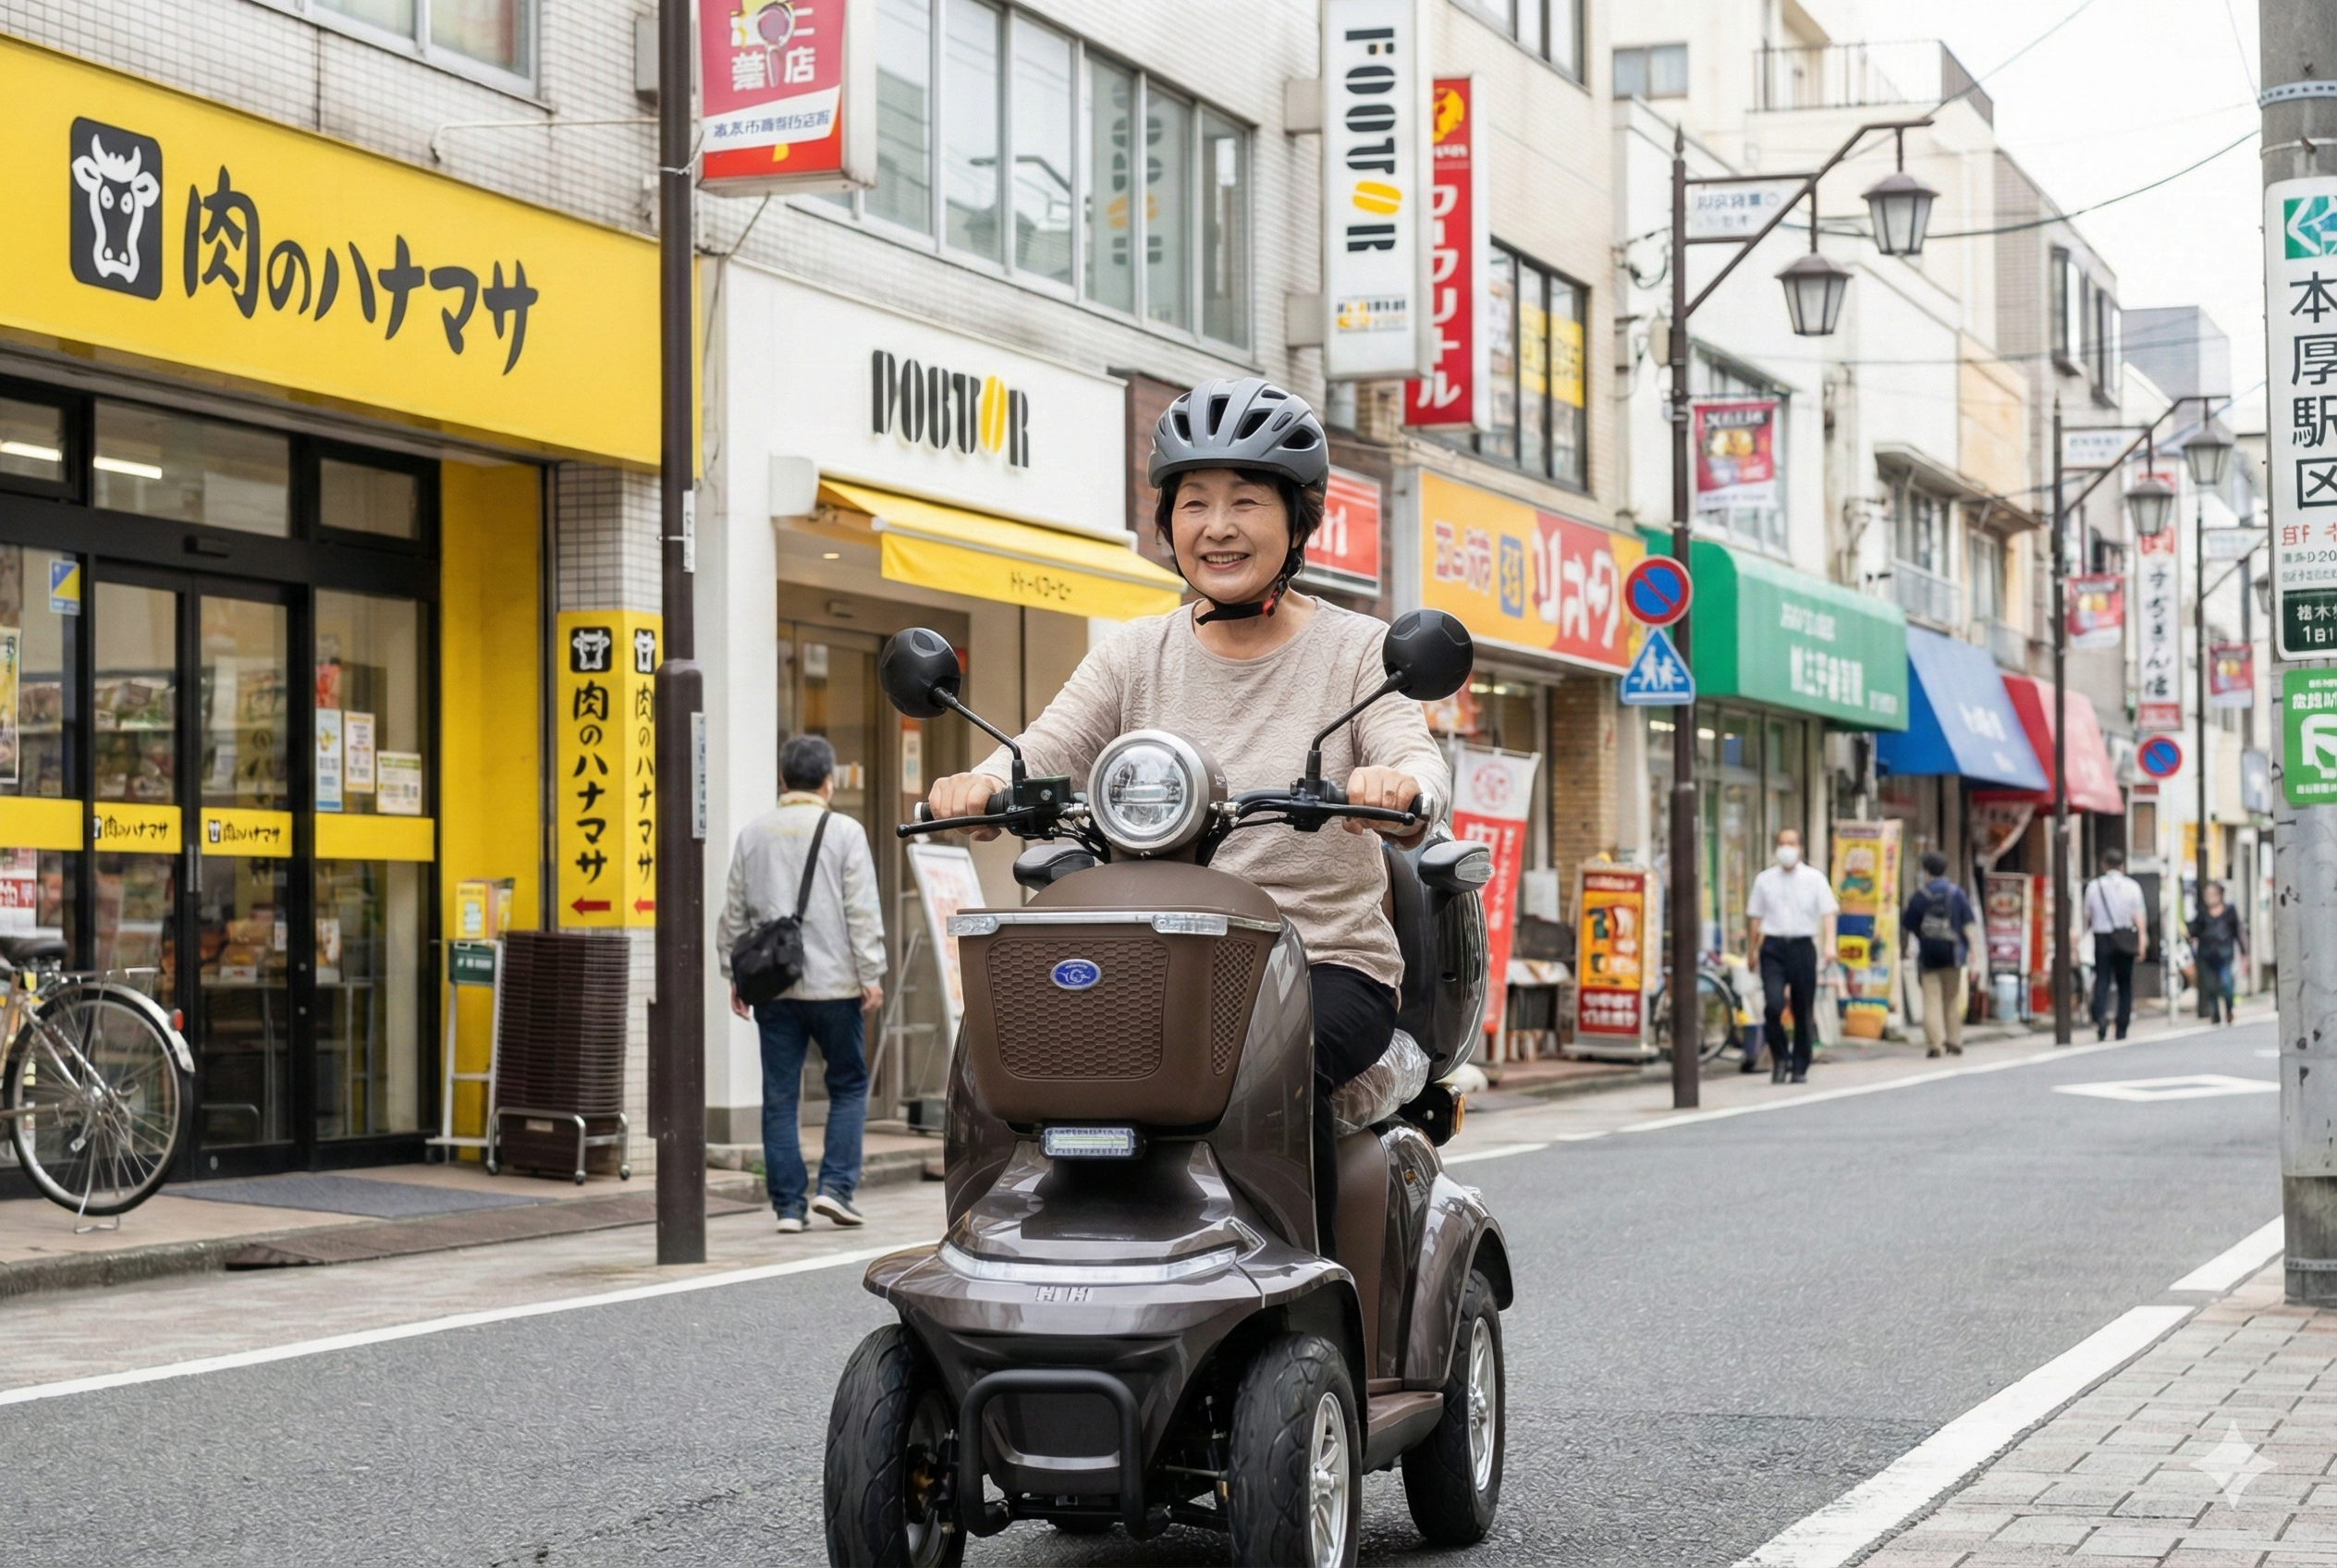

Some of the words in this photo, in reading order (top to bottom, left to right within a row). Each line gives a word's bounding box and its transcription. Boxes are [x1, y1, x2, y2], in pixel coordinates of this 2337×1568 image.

[183, 164, 539, 377] 肉のハナマサ
[104, 815, 169, 840] 肉のハナマサ
[223, 820, 281, 843] 肉のハナマサ
[572, 679, 610, 886] 肉のハナマサ
[634, 681, 655, 886] 肉のハナマサ
